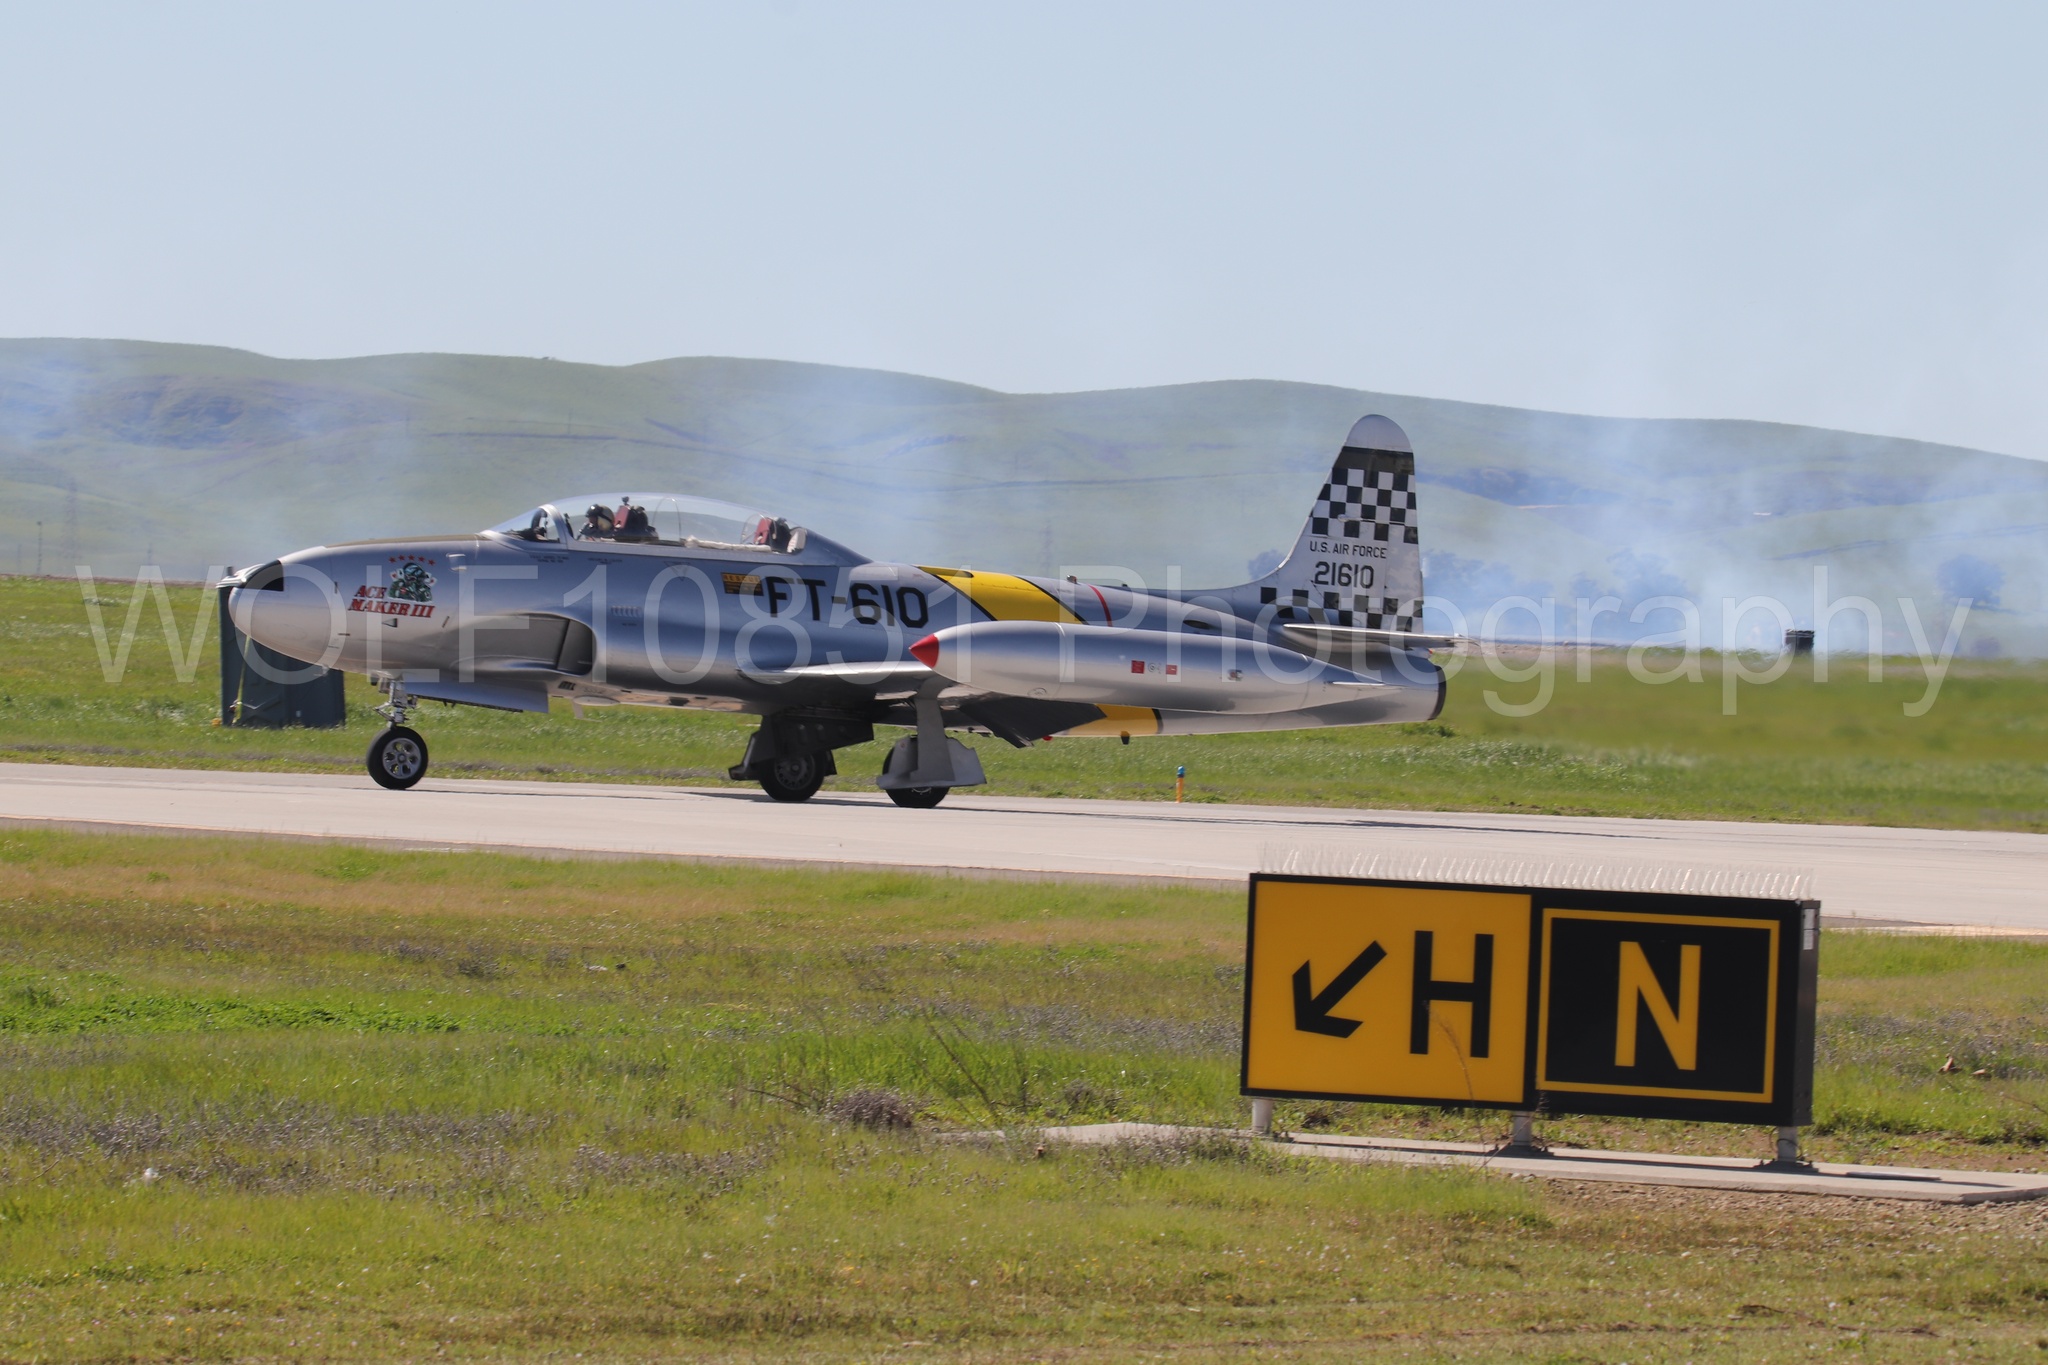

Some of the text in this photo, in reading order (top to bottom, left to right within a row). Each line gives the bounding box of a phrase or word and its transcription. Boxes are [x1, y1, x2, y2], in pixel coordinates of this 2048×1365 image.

[1309, 541, 1388, 559] U.S. AIR FORCE
[1314, 561, 1375, 589] 21610
[354, 585, 388, 599] ACE
[765, 576, 929, 629] FT-610
[348, 598, 436, 618] MAKER III
[1410, 930, 1494, 1058] H
[1614, 941, 1701, 1070] N
